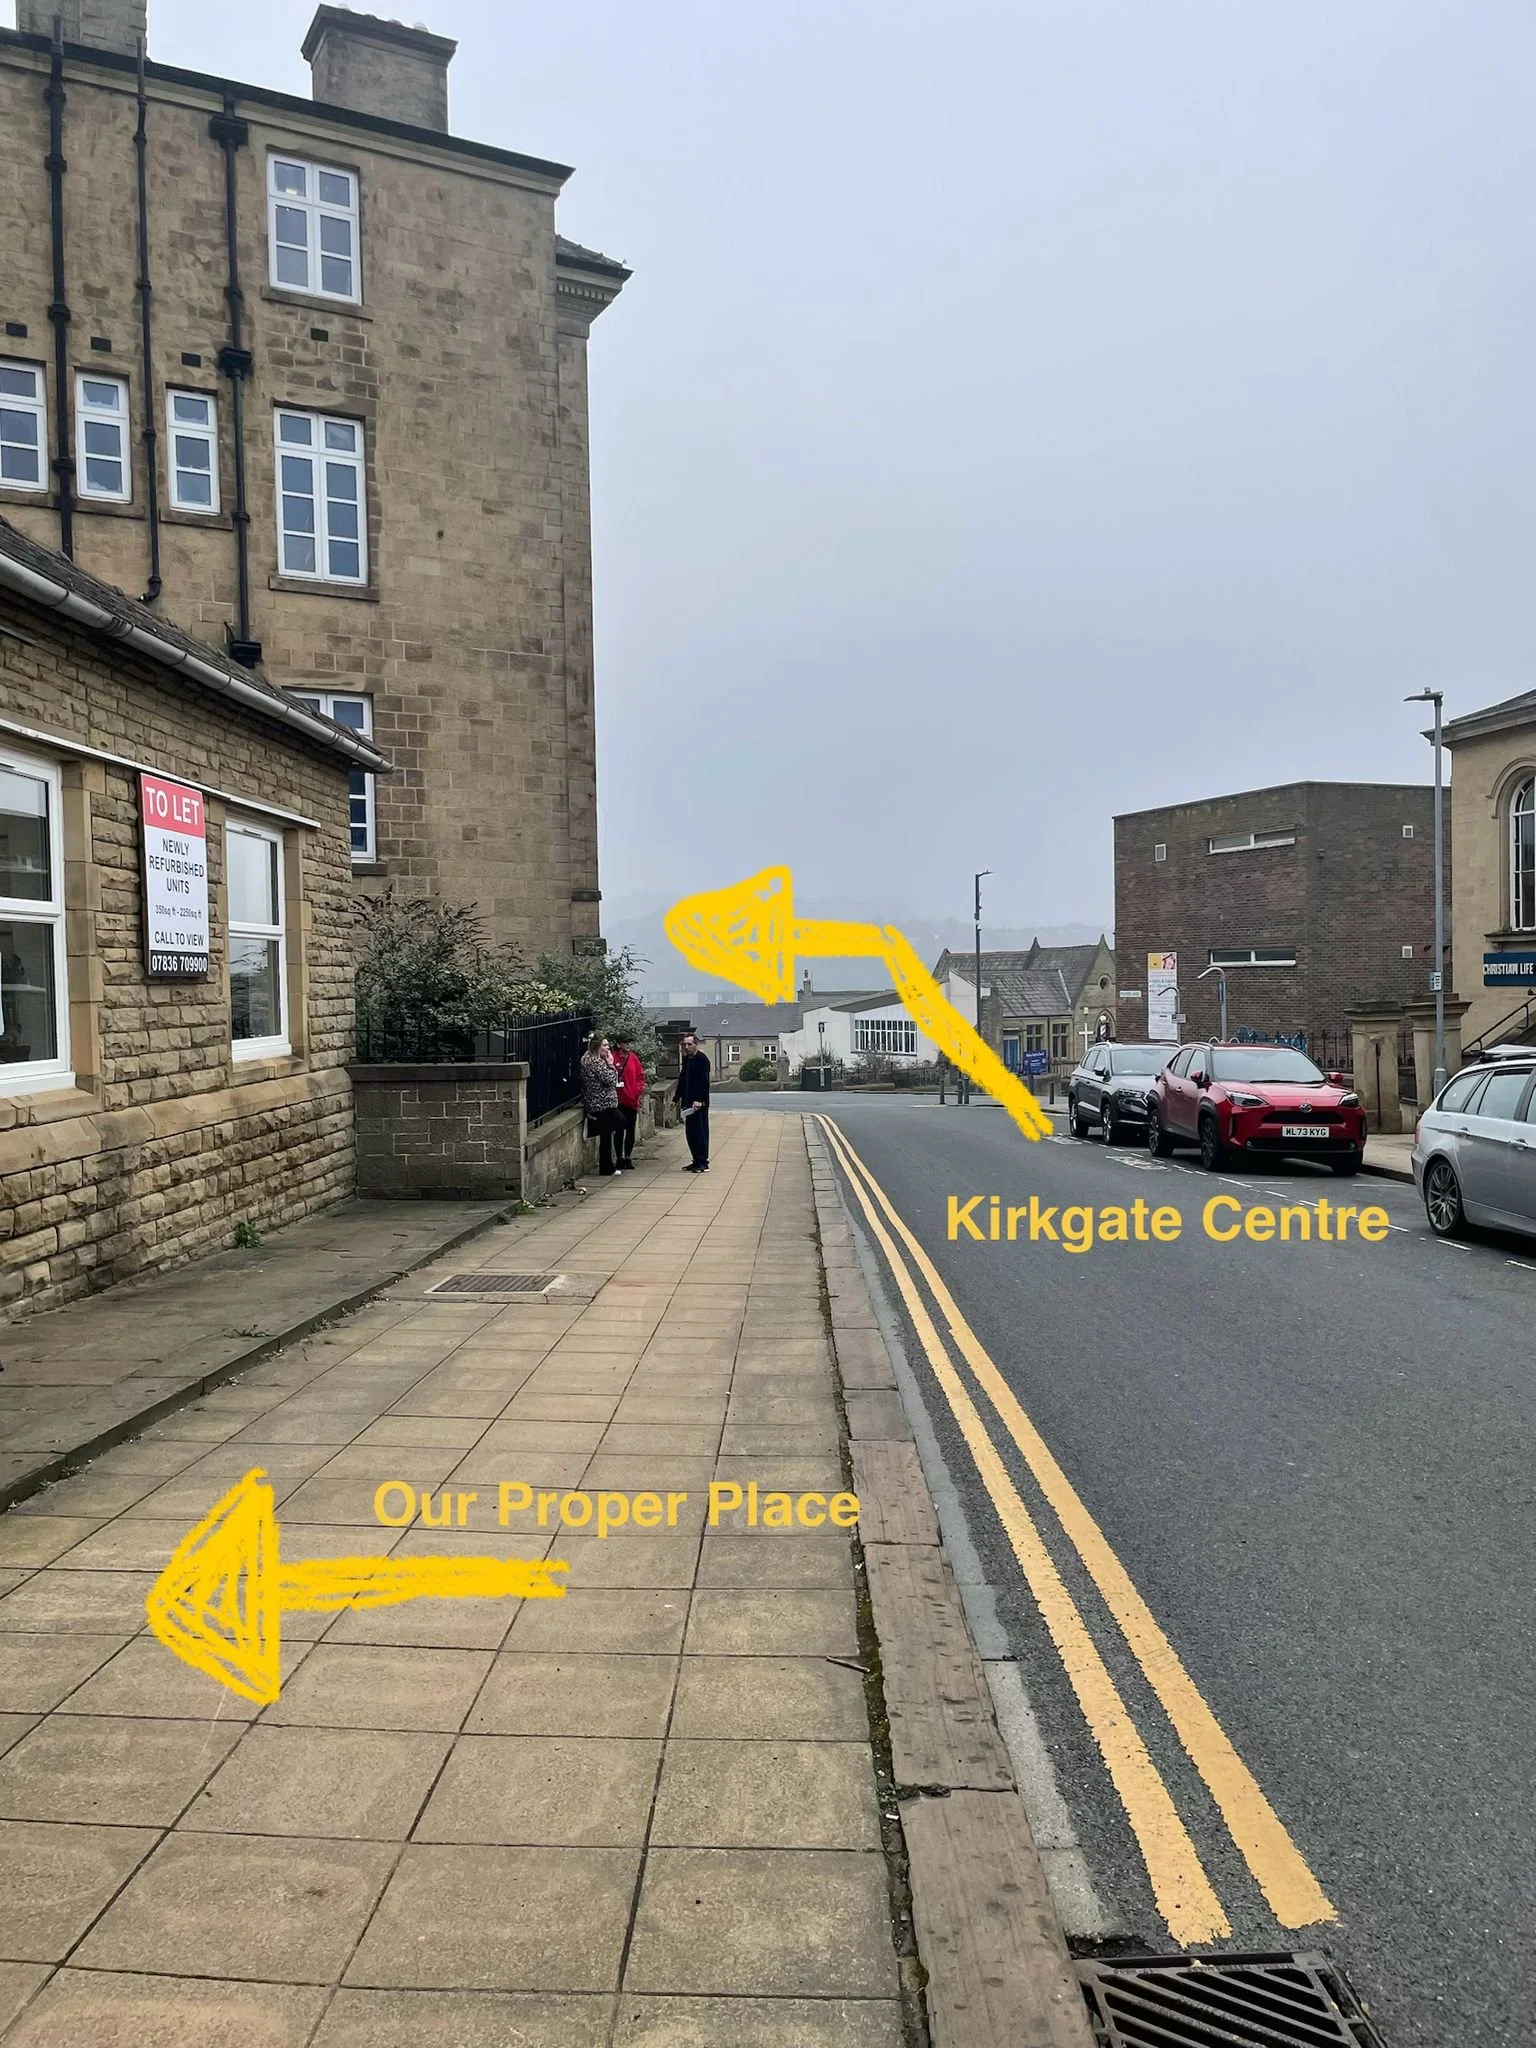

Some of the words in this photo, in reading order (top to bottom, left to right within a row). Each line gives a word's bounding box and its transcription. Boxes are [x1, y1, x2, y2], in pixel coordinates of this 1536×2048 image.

[145, 786, 168, 818] TO
[172, 794, 200, 826] LET
[162, 838, 190, 857] NEWLY
[149, 854, 205, 878] REFURBISHED
[166, 878, 190, 894] UNITS
[154, 931, 174, 945] CALL
[175, 932, 185, 946] TO
[186, 934, 204, 947] VIEW
[152, 954, 178, 972] 07836
[179, 956, 208, 972] 709900
[1482, 963, 1519, 975] CHRISTIAN
[1519, 962, 1534, 975] LIFE
[1309, 1127, 1327, 1137] KYG
